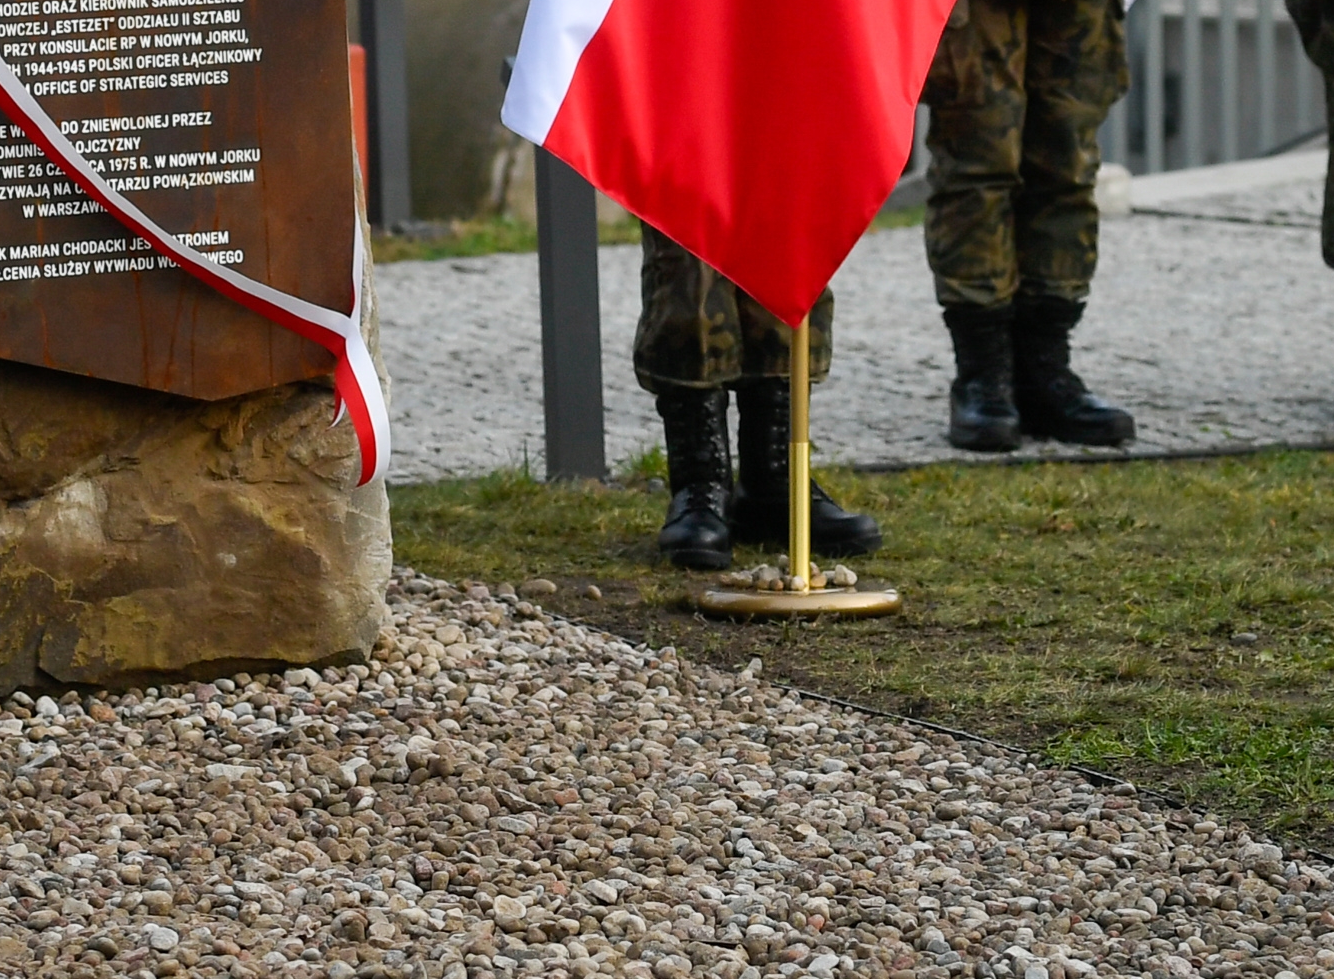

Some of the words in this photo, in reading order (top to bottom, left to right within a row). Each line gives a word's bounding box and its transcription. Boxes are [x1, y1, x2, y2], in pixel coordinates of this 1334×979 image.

[42, 0, 76, 14] ORAZ
[118, 13, 178, 29] ODDZIAŁU
[182, 13, 189, 25] II
[193, 10, 240, 25] SZTABU
[3, 43, 36, 57] PRZY
[39, 37, 117, 55] KONSULACIE
[120, 36, 136, 49] RP
[139, 35, 151, 48] W
[154, 32, 202, 47] NOWYM
[205, 29, 249, 44] JORKU,
[24, 60, 85, 76] 1944-1945
[88, 57, 132, 72] POLSKI
[136, 54, 179, 69] OFICER
[182, 48, 262, 68] ŁĄCZNIKOWY
[33, 80, 77, 96] OFFICE
[80, 79, 96, 92] OF
[99, 75, 167, 91] STRATEGIC
[170, 71, 228, 87] SERVICES
[61, 121, 78, 135] DO
[81, 115, 168, 133] ZNIEWOLONEJ
[172, 112, 212, 127] PRZEZ
[76, 137, 140, 154] OJCZYZNY
[28, 164, 43, 177] 26
[108, 157, 136, 171] 1975
[140, 156, 151, 169] R.
[154, 155, 166, 168] W
[169, 152, 216, 167] NOWYM
[220, 149, 260, 164] JORKU
[53, 183, 71, 195] NA
[153, 169, 254, 189] POWĄZKOWSKIM
[22, 205, 34, 218] W
[10, 244, 59, 259] MARIAN
[63, 239, 125, 255] CHODACKI
[44, 261, 90, 277] SŁUŻBY
[94, 257, 153, 273] WYWIADU
